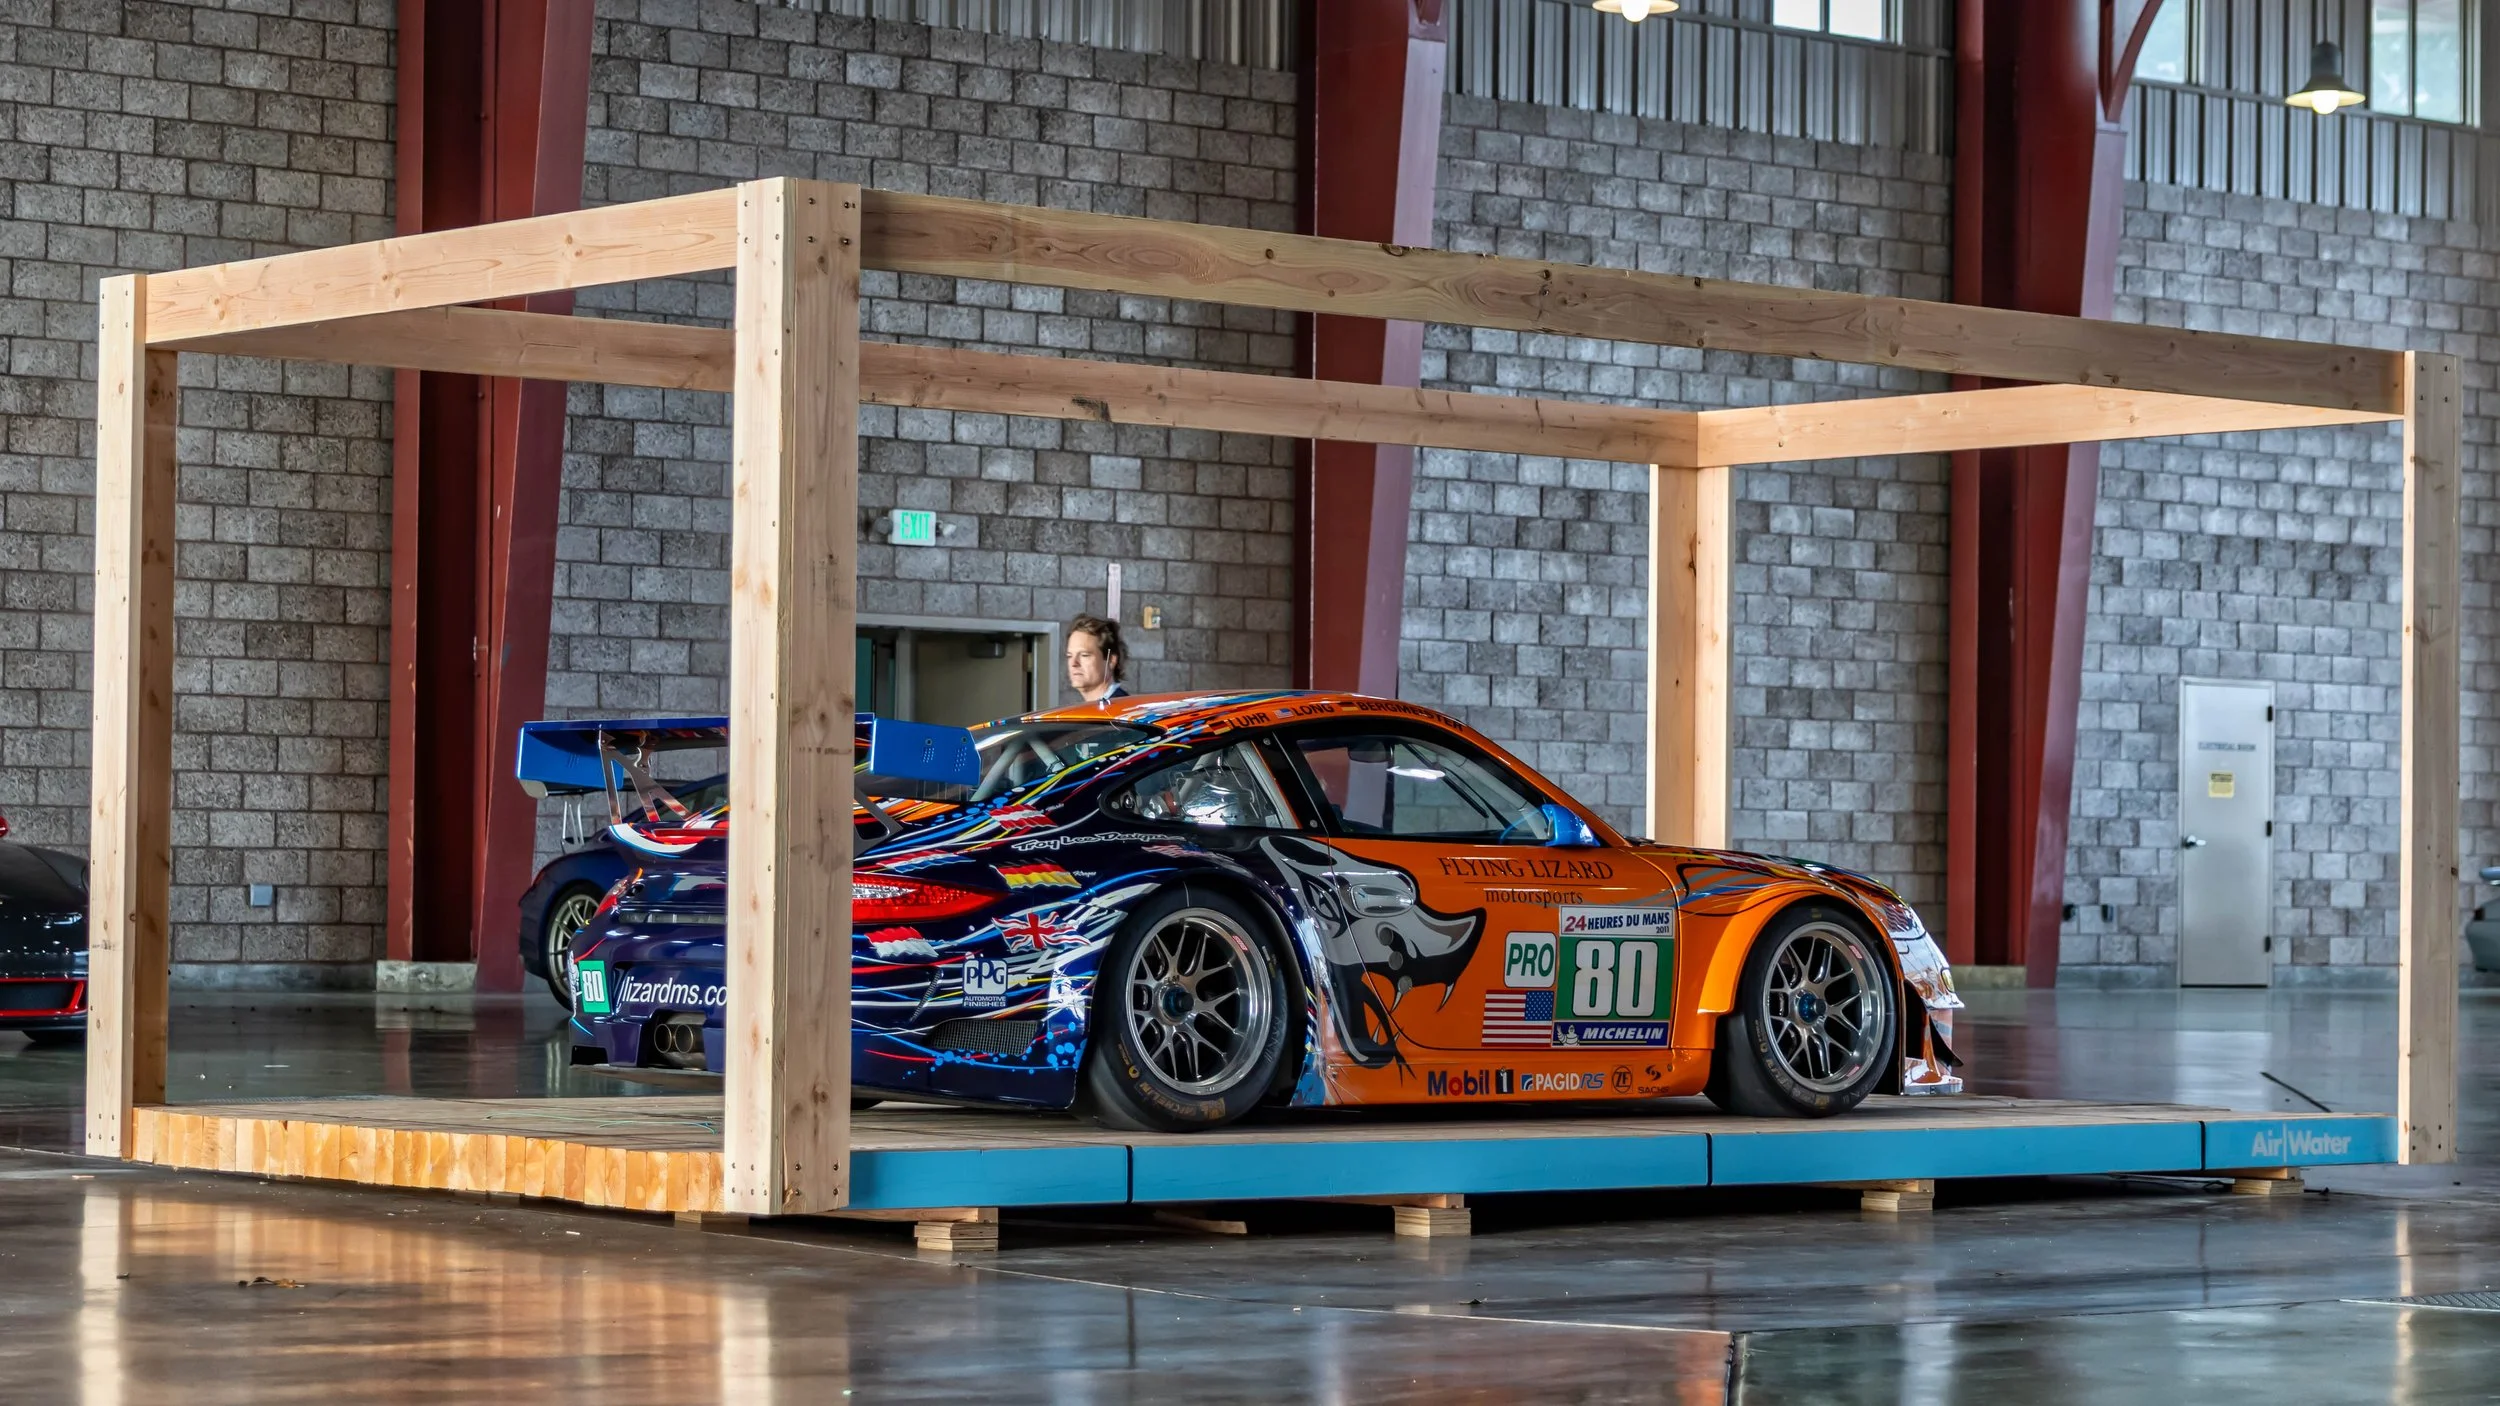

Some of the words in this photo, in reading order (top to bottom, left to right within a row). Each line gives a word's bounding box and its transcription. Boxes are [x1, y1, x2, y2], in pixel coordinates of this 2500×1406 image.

[901, 511, 930, 540] EXIT
[1292, 702, 1335, 716] LONG
[1227, 712, 1270, 729] LUHR
[1011, 839, 1060, 851] Troy
[1060, 836, 1100, 845] Lee
[1095, 831, 1180, 842] Designs
[1438, 857, 1525, 878] FLYING
[1526, 859, 1613, 879] LIZARD
[1484, 889, 1584, 908] motorsports
[1564, 915, 1586, 932] 24
[1588, 915, 1623, 930] HEURES
[1626, 914, 1640, 927] DU
[1642, 912, 1670, 926] MANS
[1656, 926, 1670, 934] 2011
[1506, 943, 1554, 977] PRO
[966, 959, 1005, 988] PPG
[1573, 940, 1658, 1017] 80
[582, 970, 605, 1002] 80
[1582, 1027, 1664, 1040] MICHELIN
[1428, 1069, 1490, 1096] Mobil
[1499, 1068, 1509, 1093] 1
[1614, 1071, 1631, 1088] ZF
